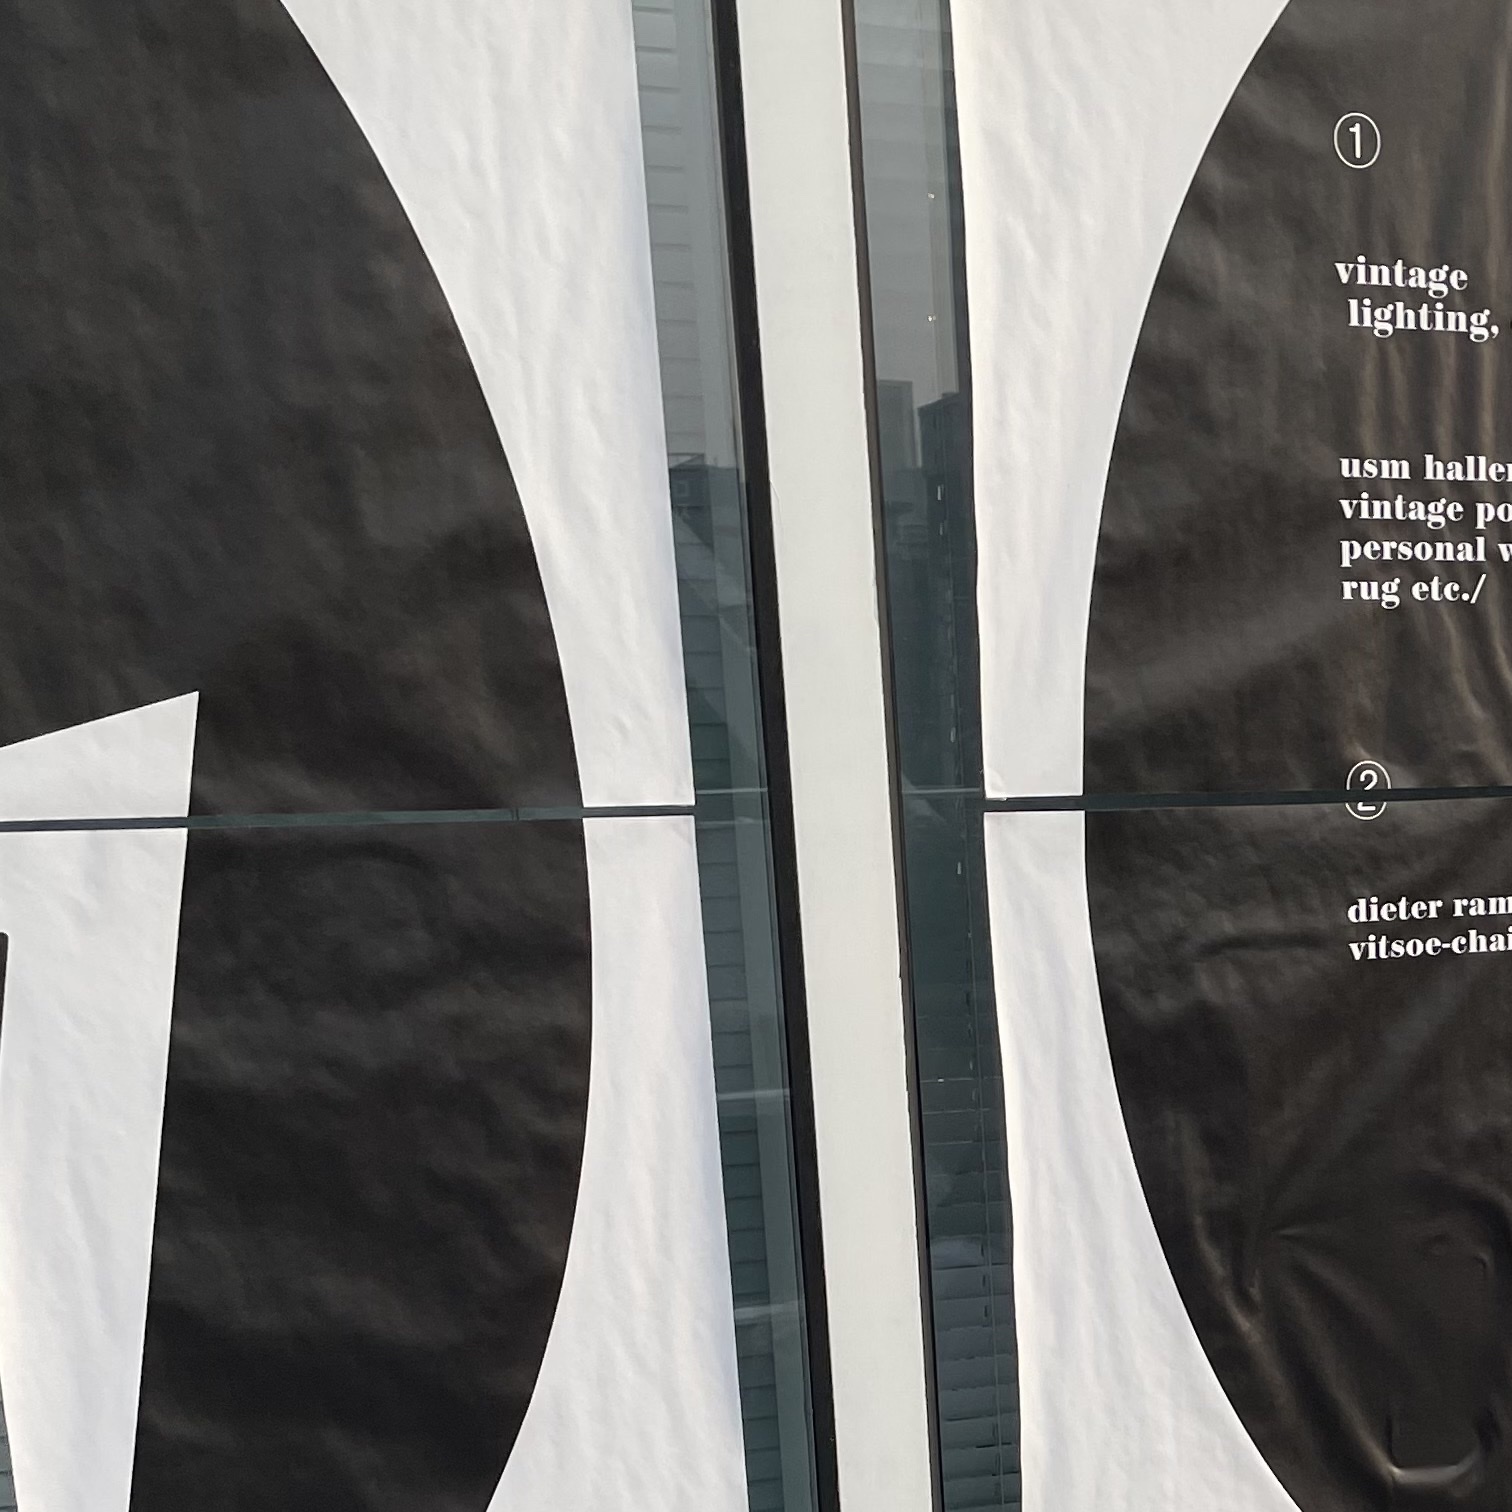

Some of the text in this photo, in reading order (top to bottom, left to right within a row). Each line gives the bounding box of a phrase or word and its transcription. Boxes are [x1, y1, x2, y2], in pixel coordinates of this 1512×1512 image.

[1335, 256, 1468, 298] vintage
[1348, 298, 1499, 342] lighting,
[1340, 459, 1411, 480] usm
[1339, 492, 1464, 529] vintage
[1340, 537, 1487, 568] personal
[1342, 578, 1401, 609] rug
[1348, 897, 1444, 923] dieter
